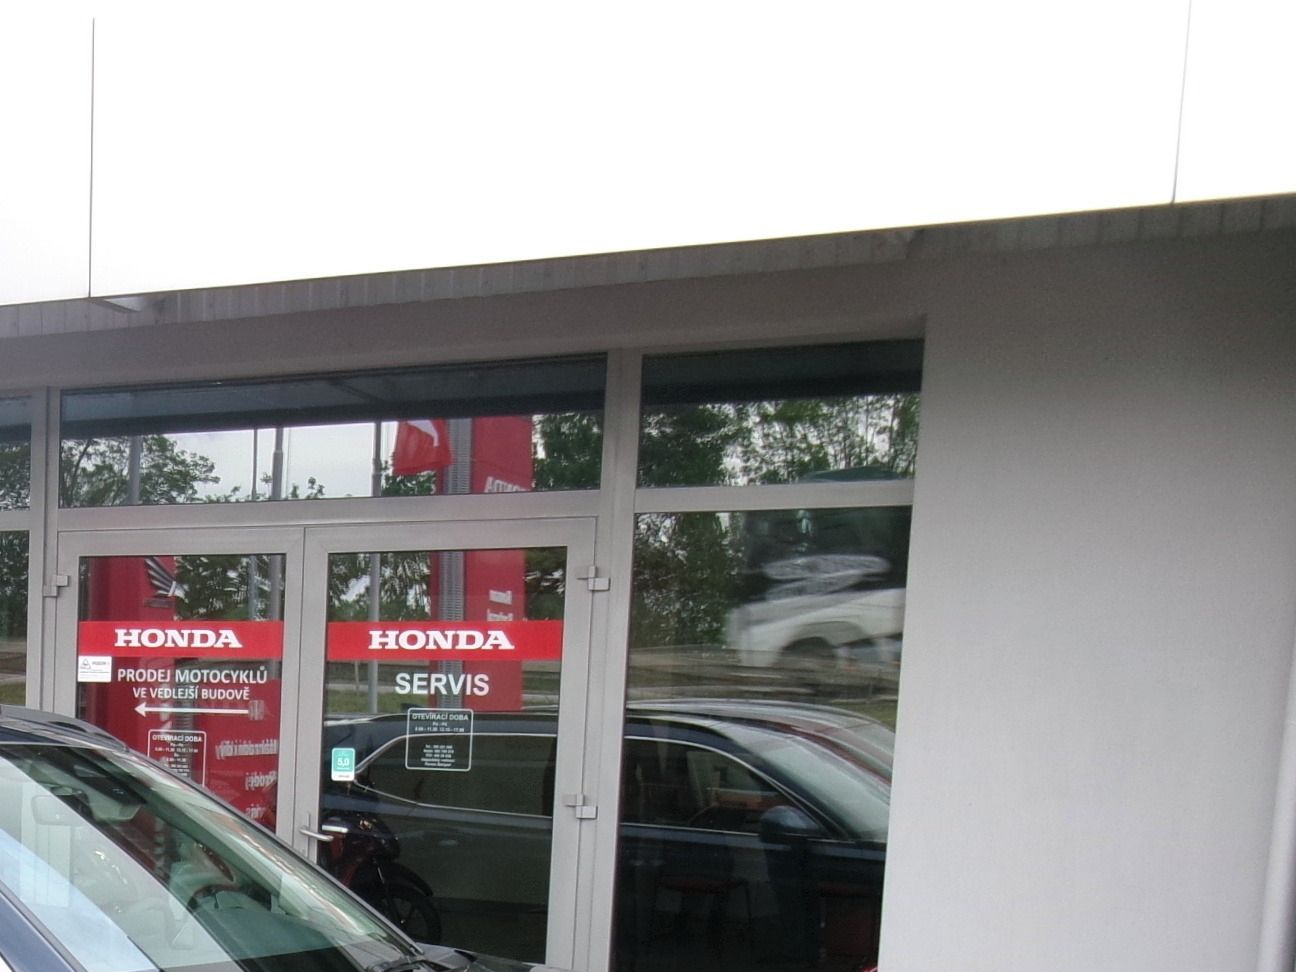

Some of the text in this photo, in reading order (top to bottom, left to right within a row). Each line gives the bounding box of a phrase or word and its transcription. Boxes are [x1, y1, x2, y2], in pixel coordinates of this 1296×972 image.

[114, 628, 243, 649] HONDA
[368, 629, 515, 650] HONDA
[117, 668, 171, 683] PRODEJ
[175, 665, 267, 684] MOTOCYKLŮ
[394, 672, 490, 696] SERVIS
[133, 685, 250, 700] VE VEDLEJŠÍ BUDOVĚ
[449, 713, 469, 721] DOBA
